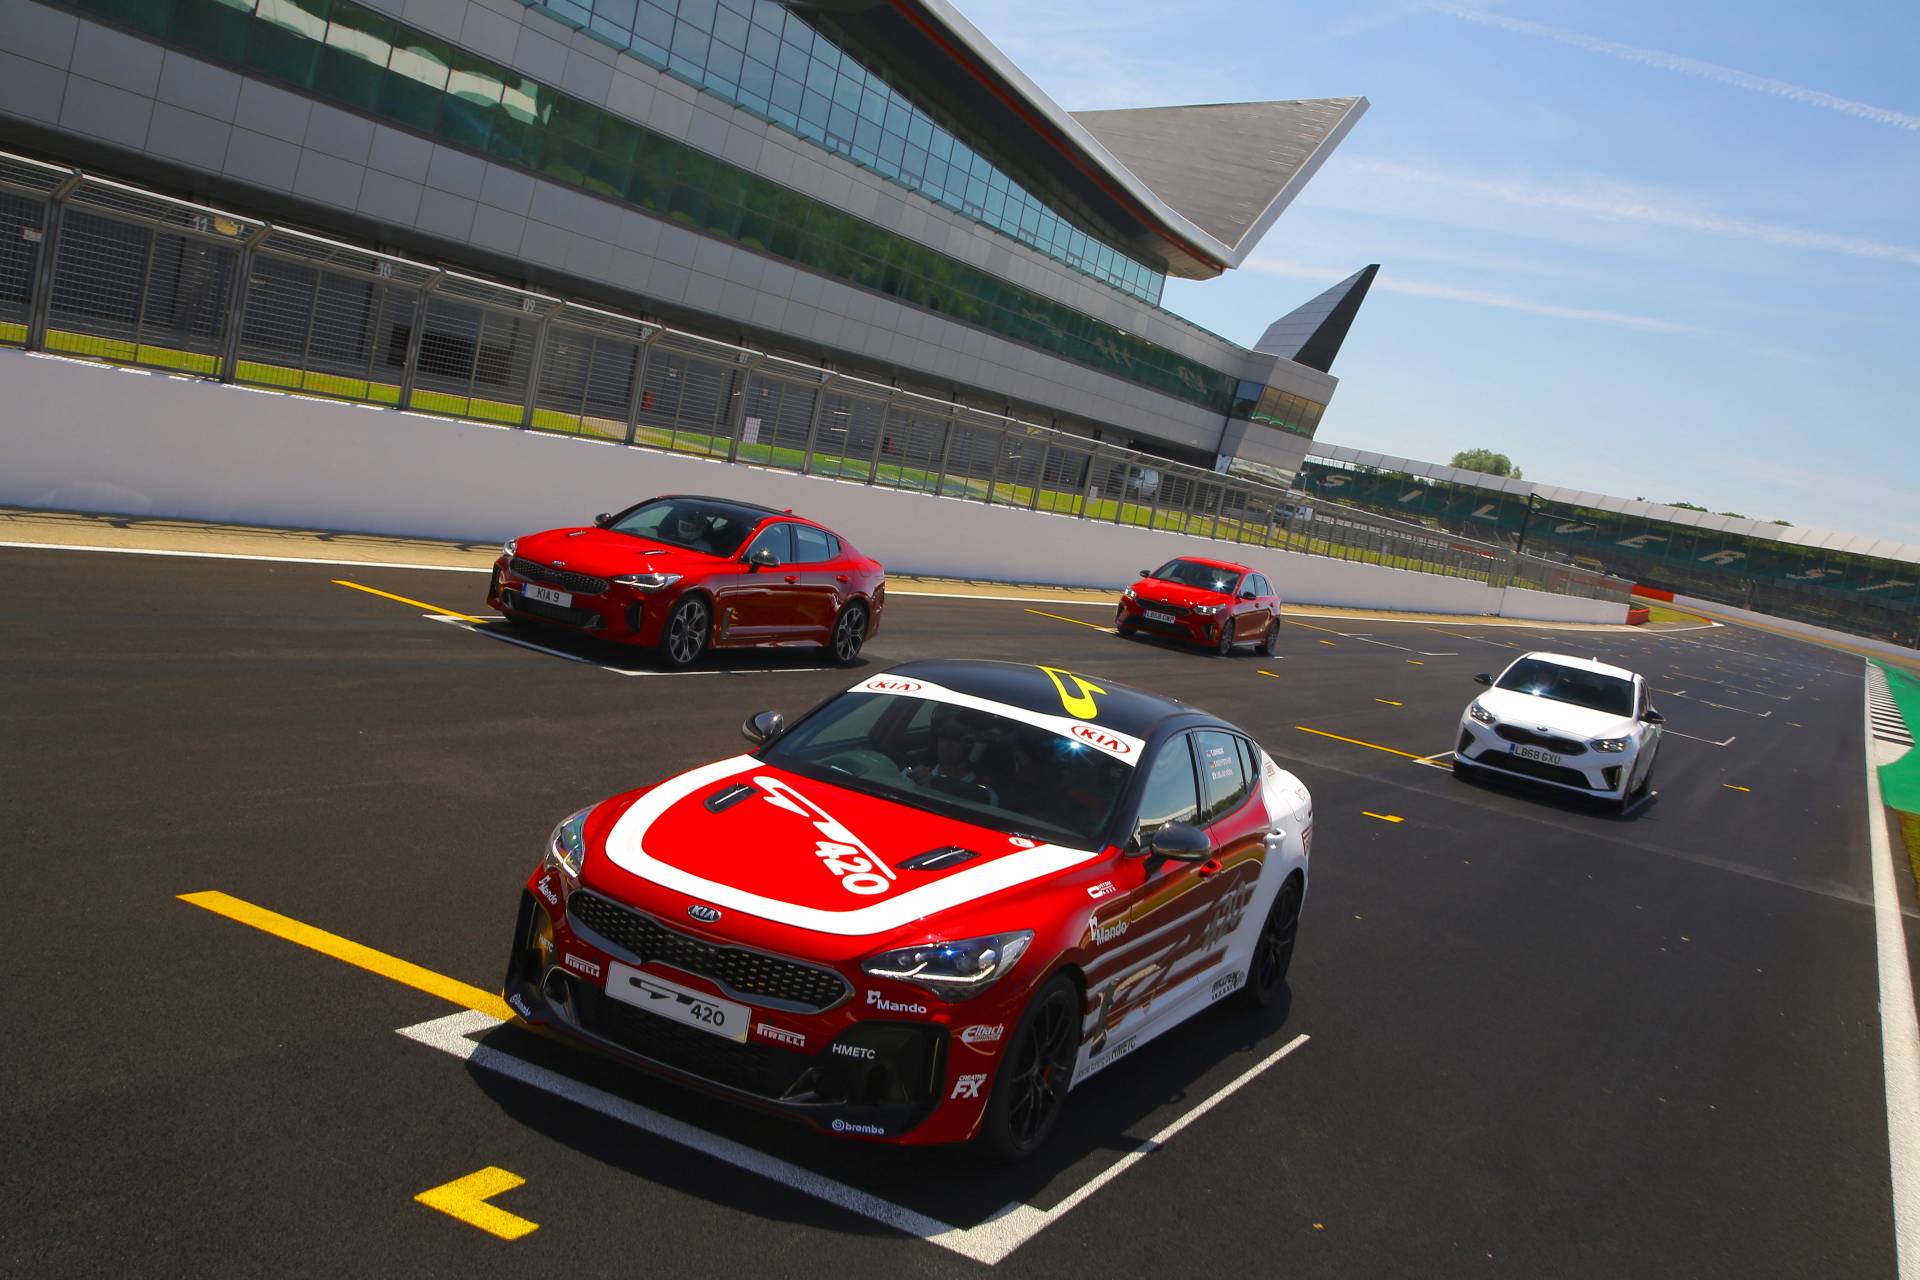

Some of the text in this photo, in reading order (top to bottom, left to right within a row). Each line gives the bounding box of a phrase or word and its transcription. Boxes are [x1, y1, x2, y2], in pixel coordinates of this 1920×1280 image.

[537, 588, 560, 603] KIA 9
[875, 681, 911, 692] KIA
[1080, 728, 1119, 751] KIA
[1515, 746, 1561, 765] LB68 GXU
[815, 841, 890, 895] 420
[538, 880, 558, 905] Mando
[691, 904, 716, 920] KIA
[1096, 921, 1129, 946] Mando
[565, 953, 600, 978] PIRELLI
[690, 1003, 725, 1028] 420
[877, 1000, 928, 1014] Mando
[757, 1023, 805, 1048] PIRELLI
[832, 1043, 876, 1060] HMETC
[951, 1080, 985, 1099] FX
[845, 1120, 885, 1136] brembo
